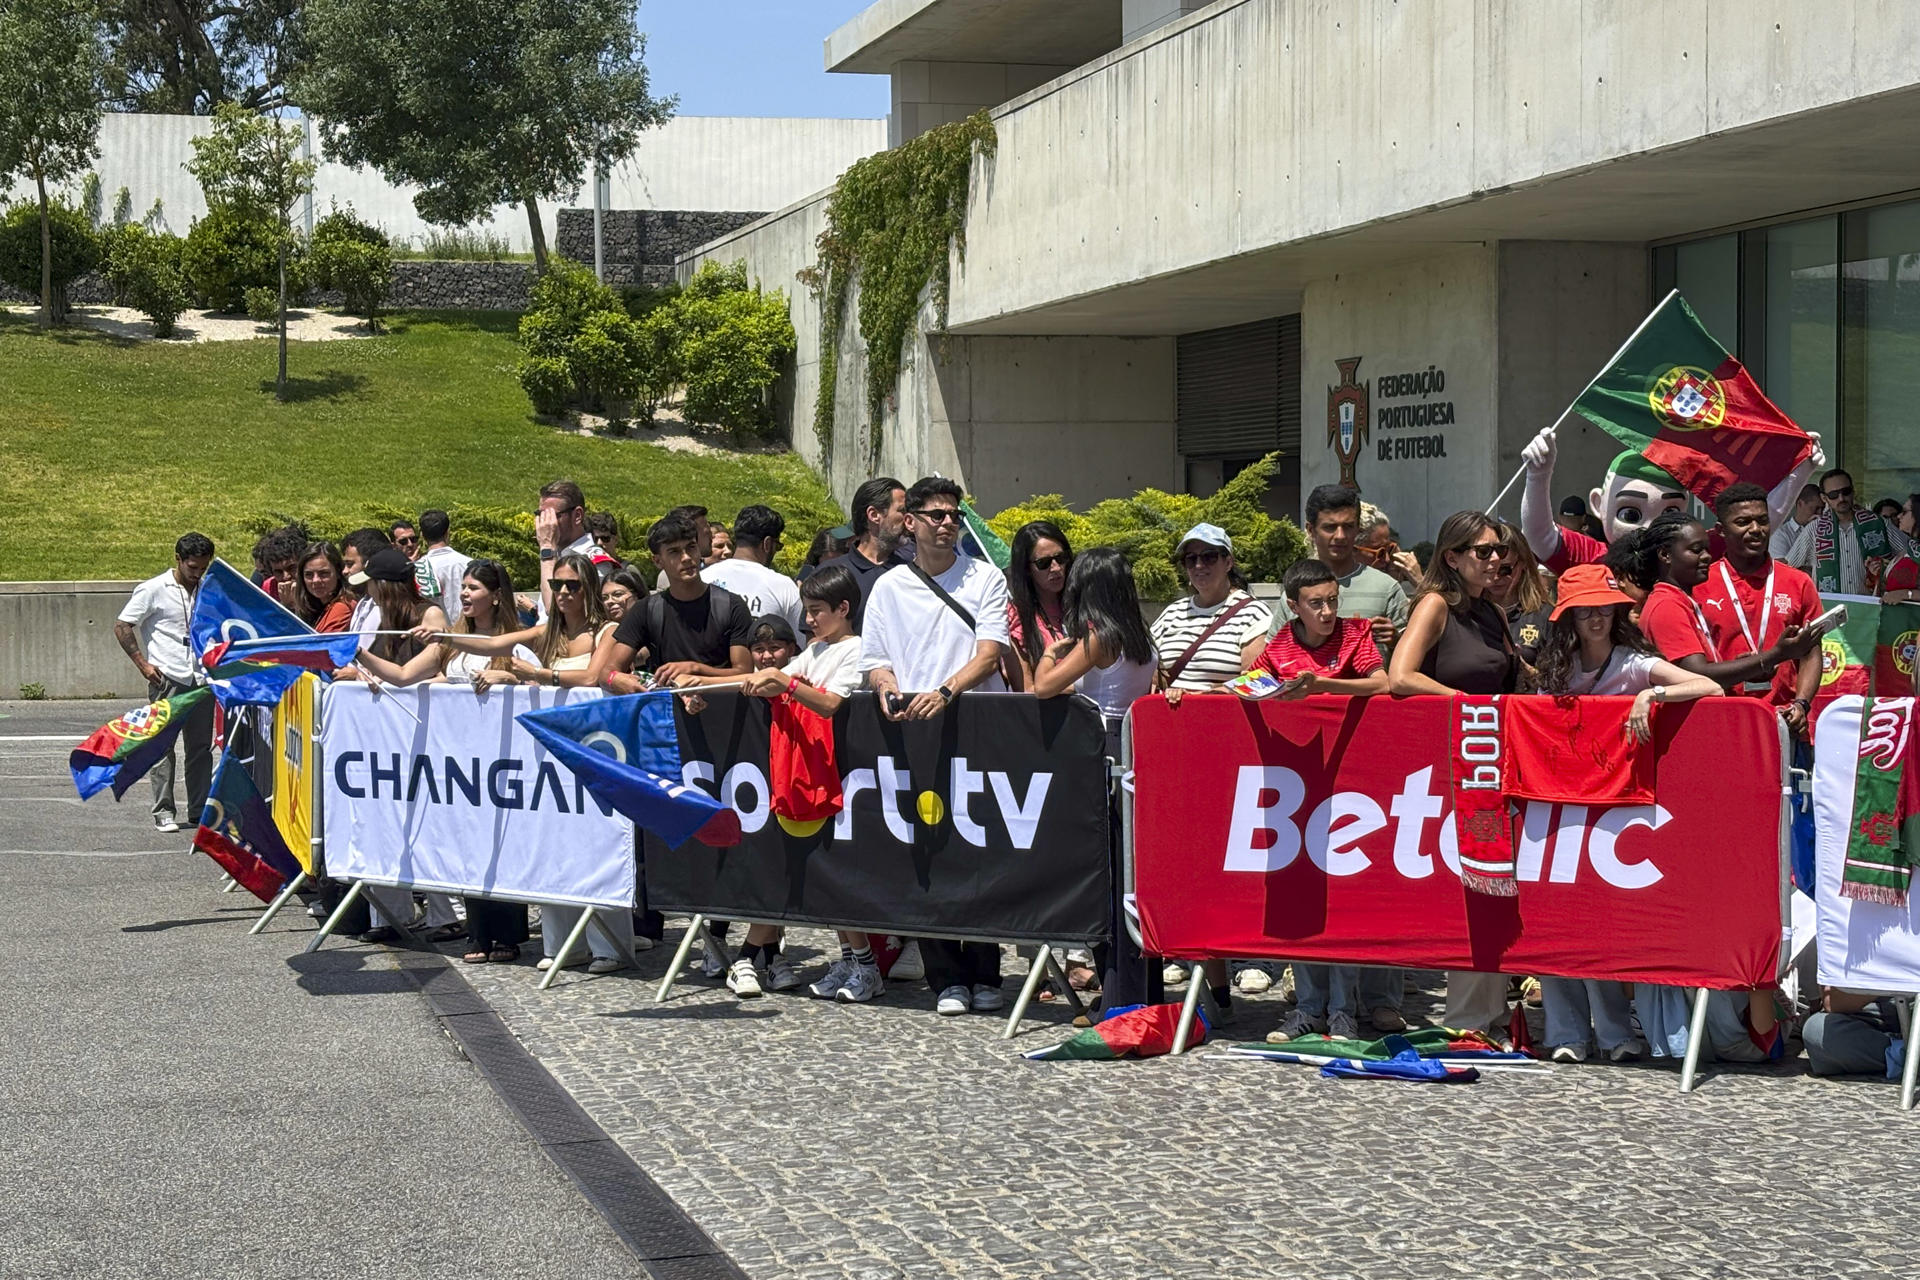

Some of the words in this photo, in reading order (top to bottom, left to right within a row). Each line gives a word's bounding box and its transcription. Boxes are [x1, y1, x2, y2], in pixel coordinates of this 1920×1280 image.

[1378, 365, 1445, 399] FEDERAÇÃO
[1378, 402, 1455, 430] PORTUGUESA
[1378, 437, 1392, 461] DE
[1395, 433, 1447, 460] FUTEBOL
